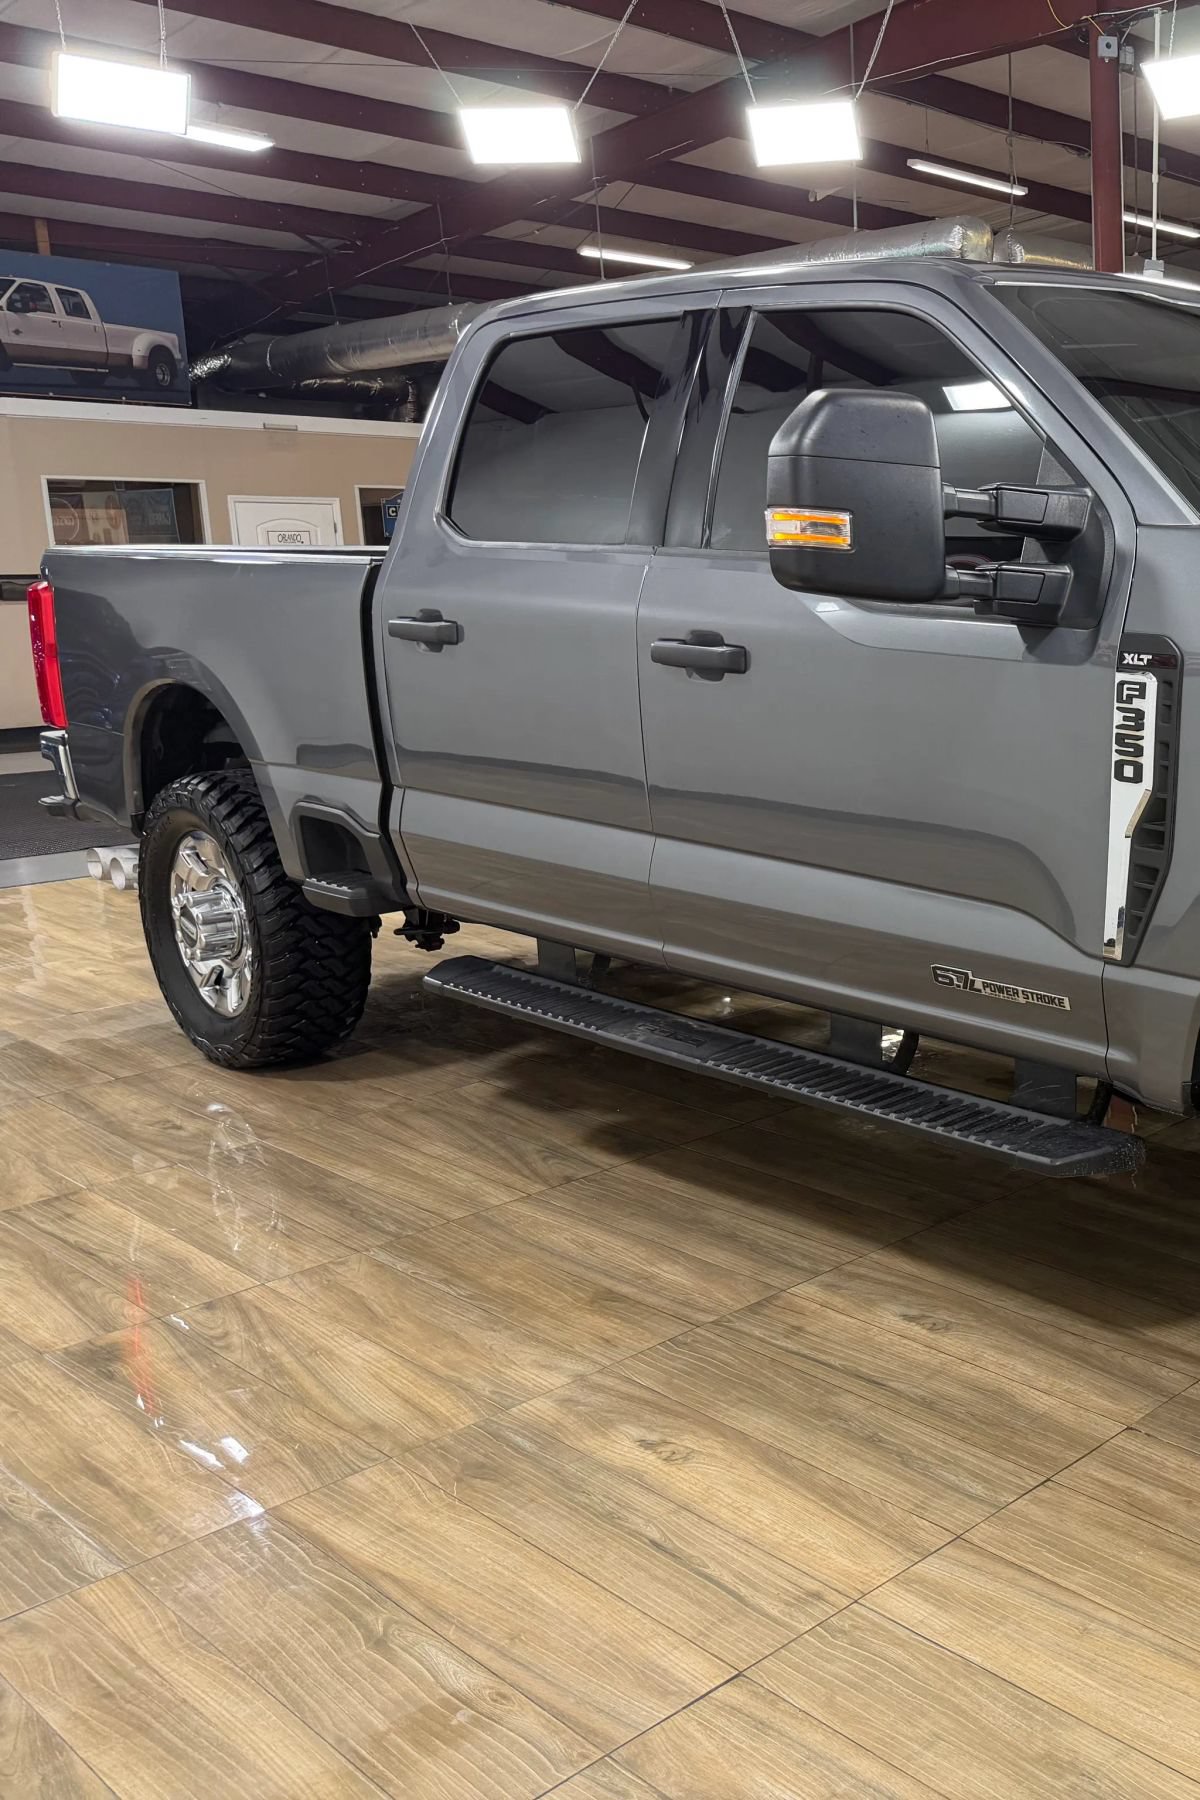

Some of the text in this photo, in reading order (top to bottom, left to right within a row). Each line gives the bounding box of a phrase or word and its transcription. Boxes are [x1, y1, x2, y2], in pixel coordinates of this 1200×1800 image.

[1122, 652, 1152, 665] XLT
[1113, 680, 1147, 784] F350
[982, 981, 1020, 998] POWER
[1021, 989, 1066, 1009] STROKE
